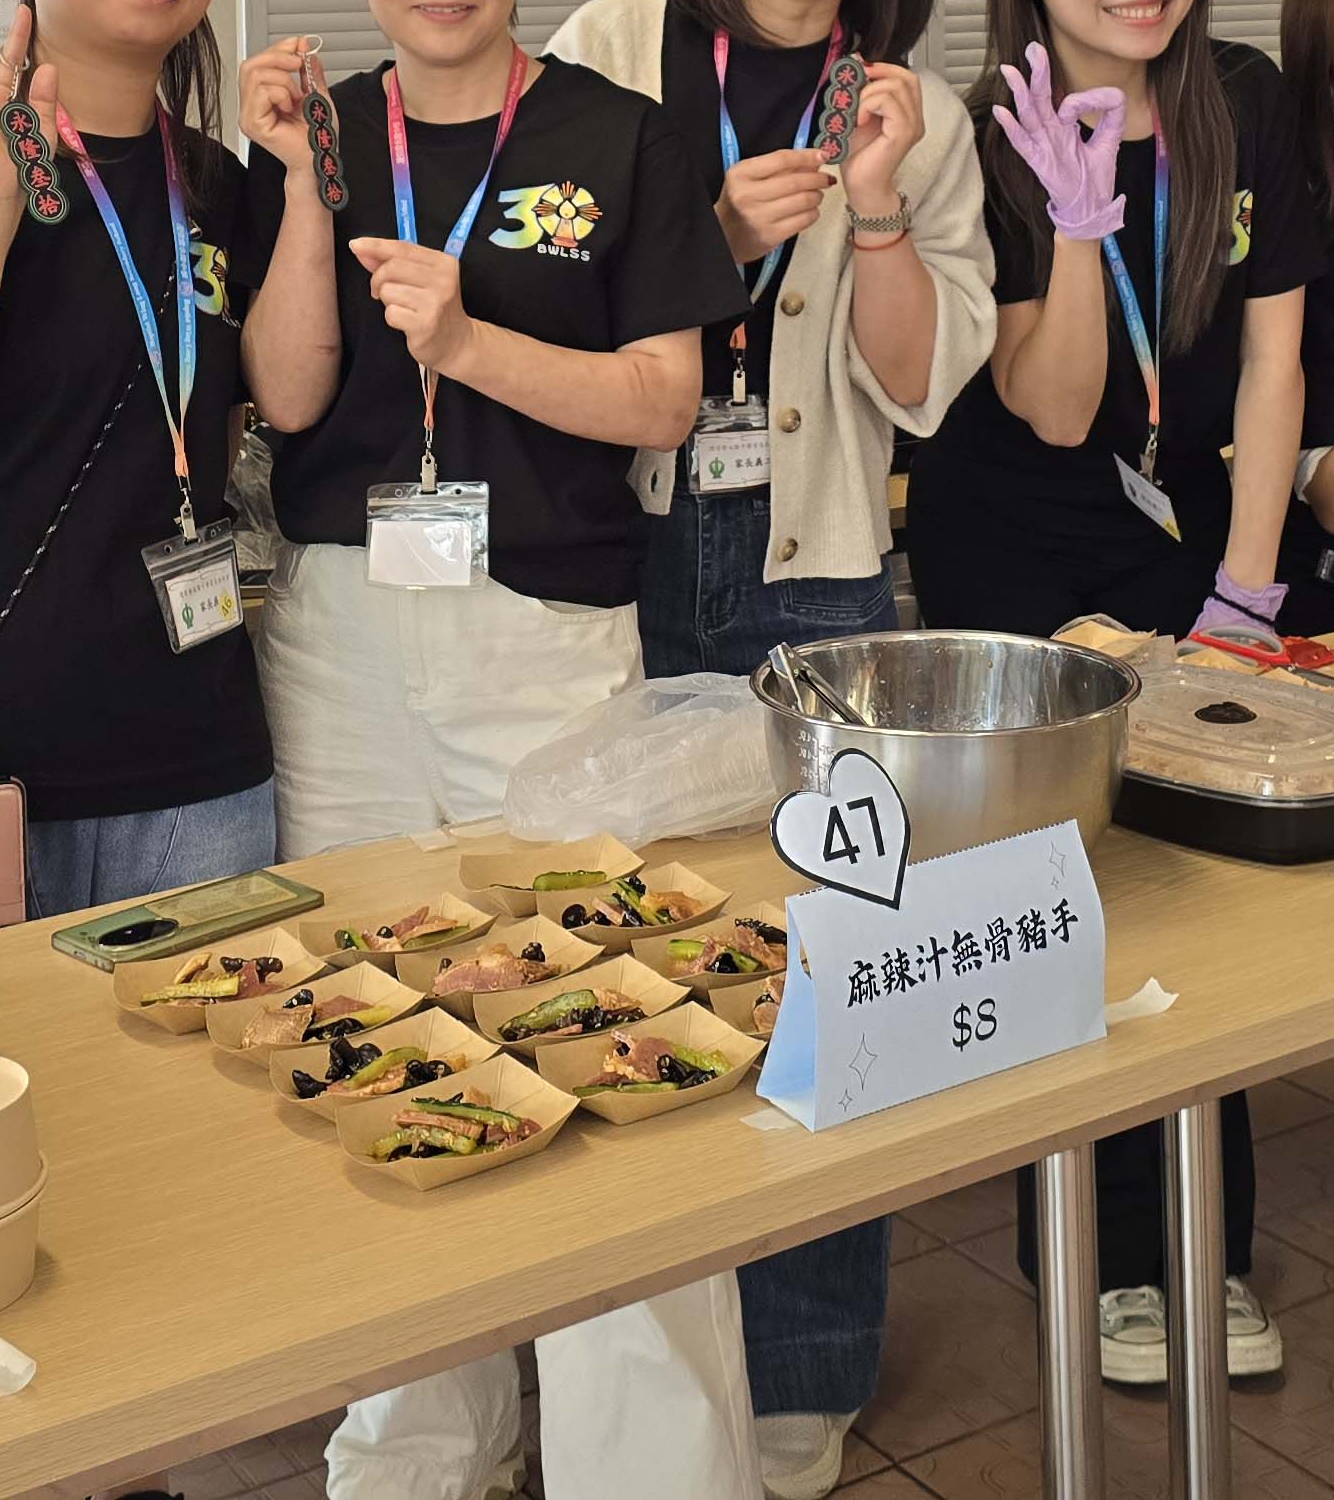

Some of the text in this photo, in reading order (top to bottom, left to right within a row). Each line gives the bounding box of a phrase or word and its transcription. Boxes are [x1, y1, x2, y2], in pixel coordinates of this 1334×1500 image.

[536, 243, 591, 261] BWLSS
[823, 796, 886, 865] 47
[847, 898, 1079, 1008] 麻辣汁無骨豬手
[951, 998, 998, 1052] $8
